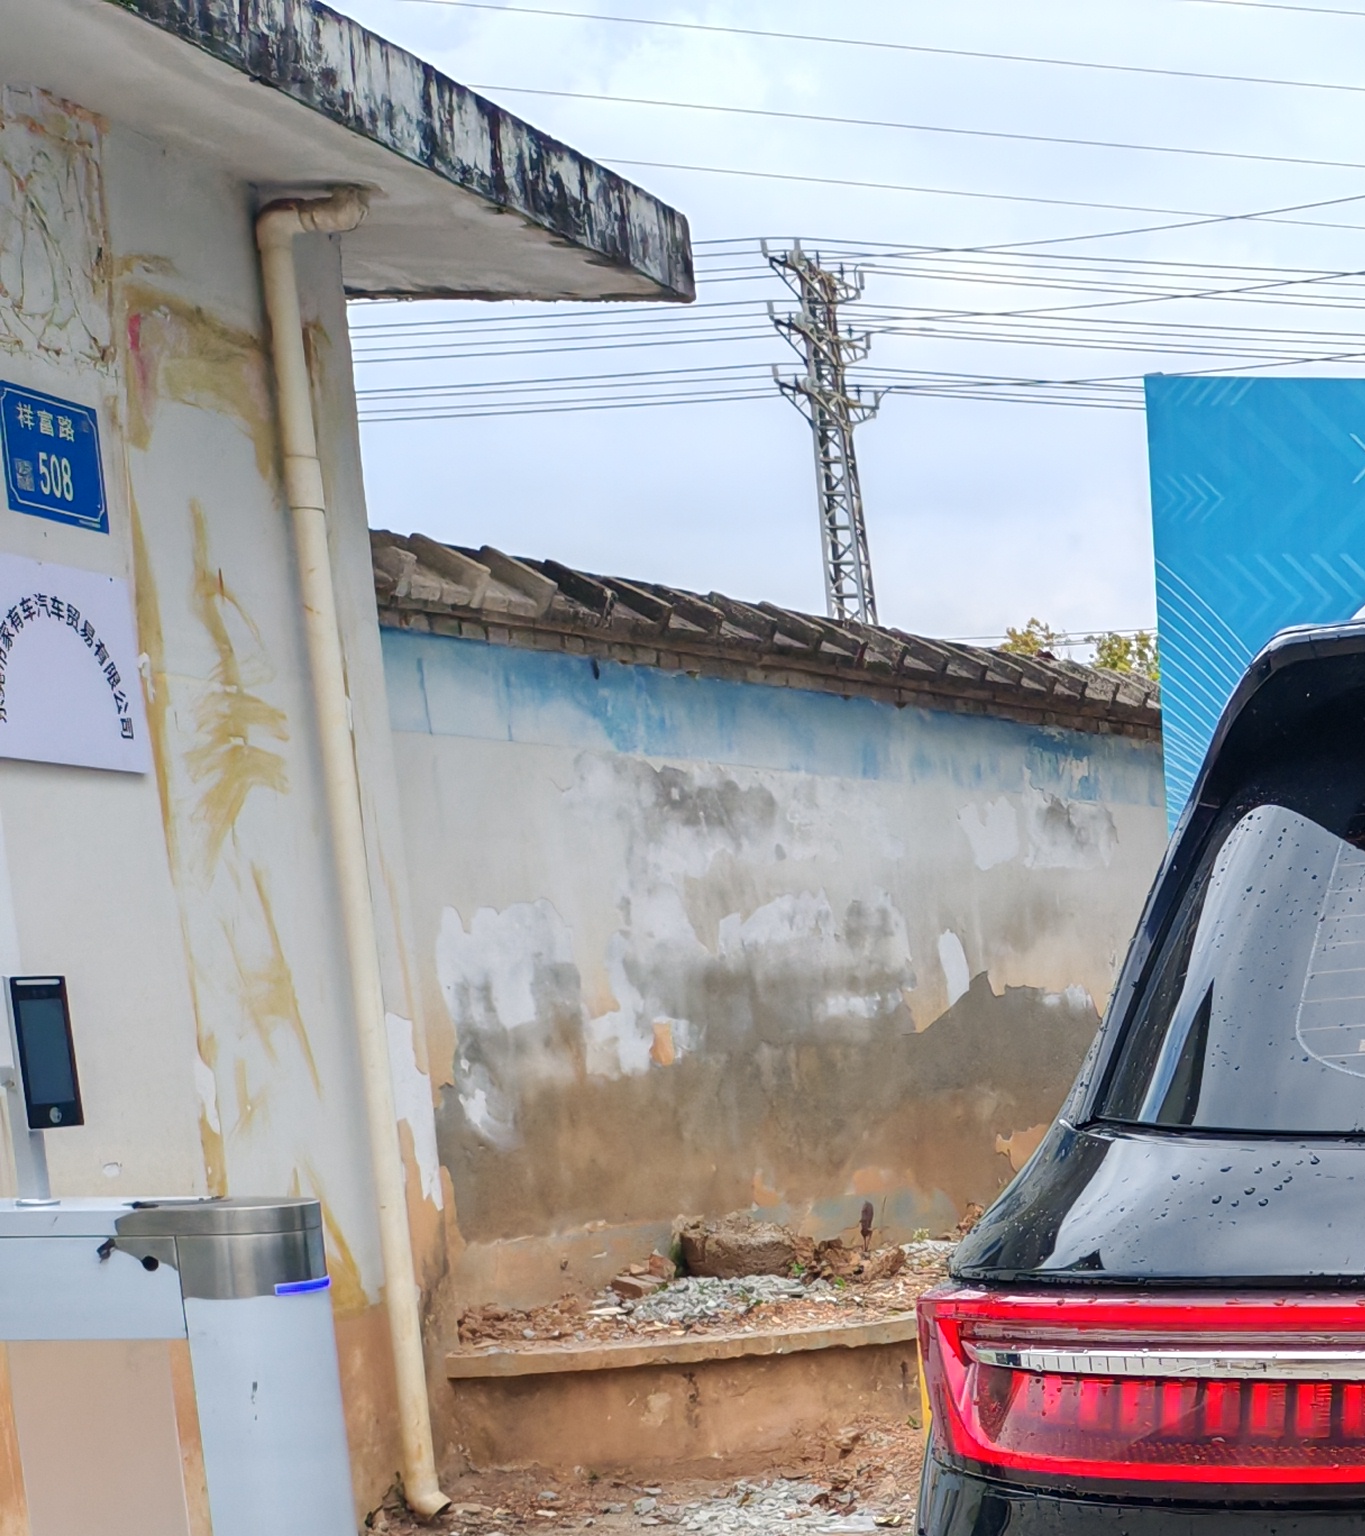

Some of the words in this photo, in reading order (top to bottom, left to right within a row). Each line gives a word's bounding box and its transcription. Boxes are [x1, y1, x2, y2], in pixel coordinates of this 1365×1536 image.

[16, 401, 75, 442] 祥富路
[38, 451, 74, 502] 508
